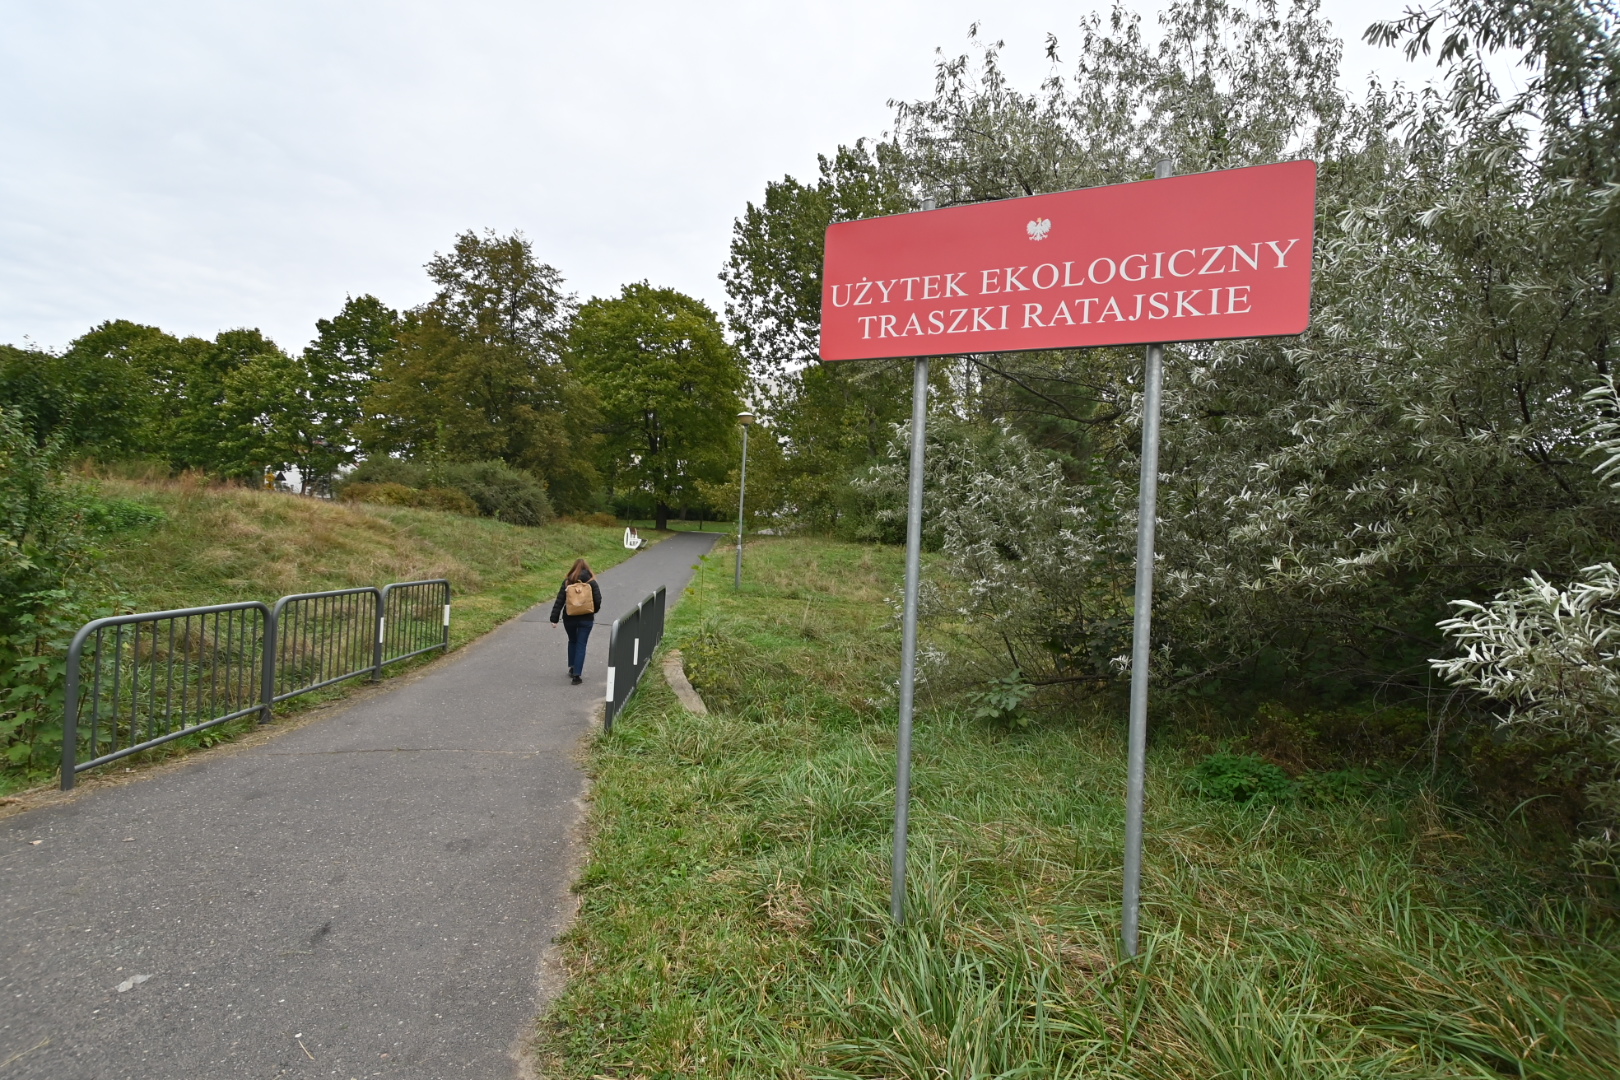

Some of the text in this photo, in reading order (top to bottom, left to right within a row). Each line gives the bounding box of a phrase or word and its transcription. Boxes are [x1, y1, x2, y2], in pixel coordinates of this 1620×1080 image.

[831, 238, 1300, 308] UŻYTEK EKOLOGICZNY
[857, 285, 1253, 340] TRASZKI RATAJSKIE
